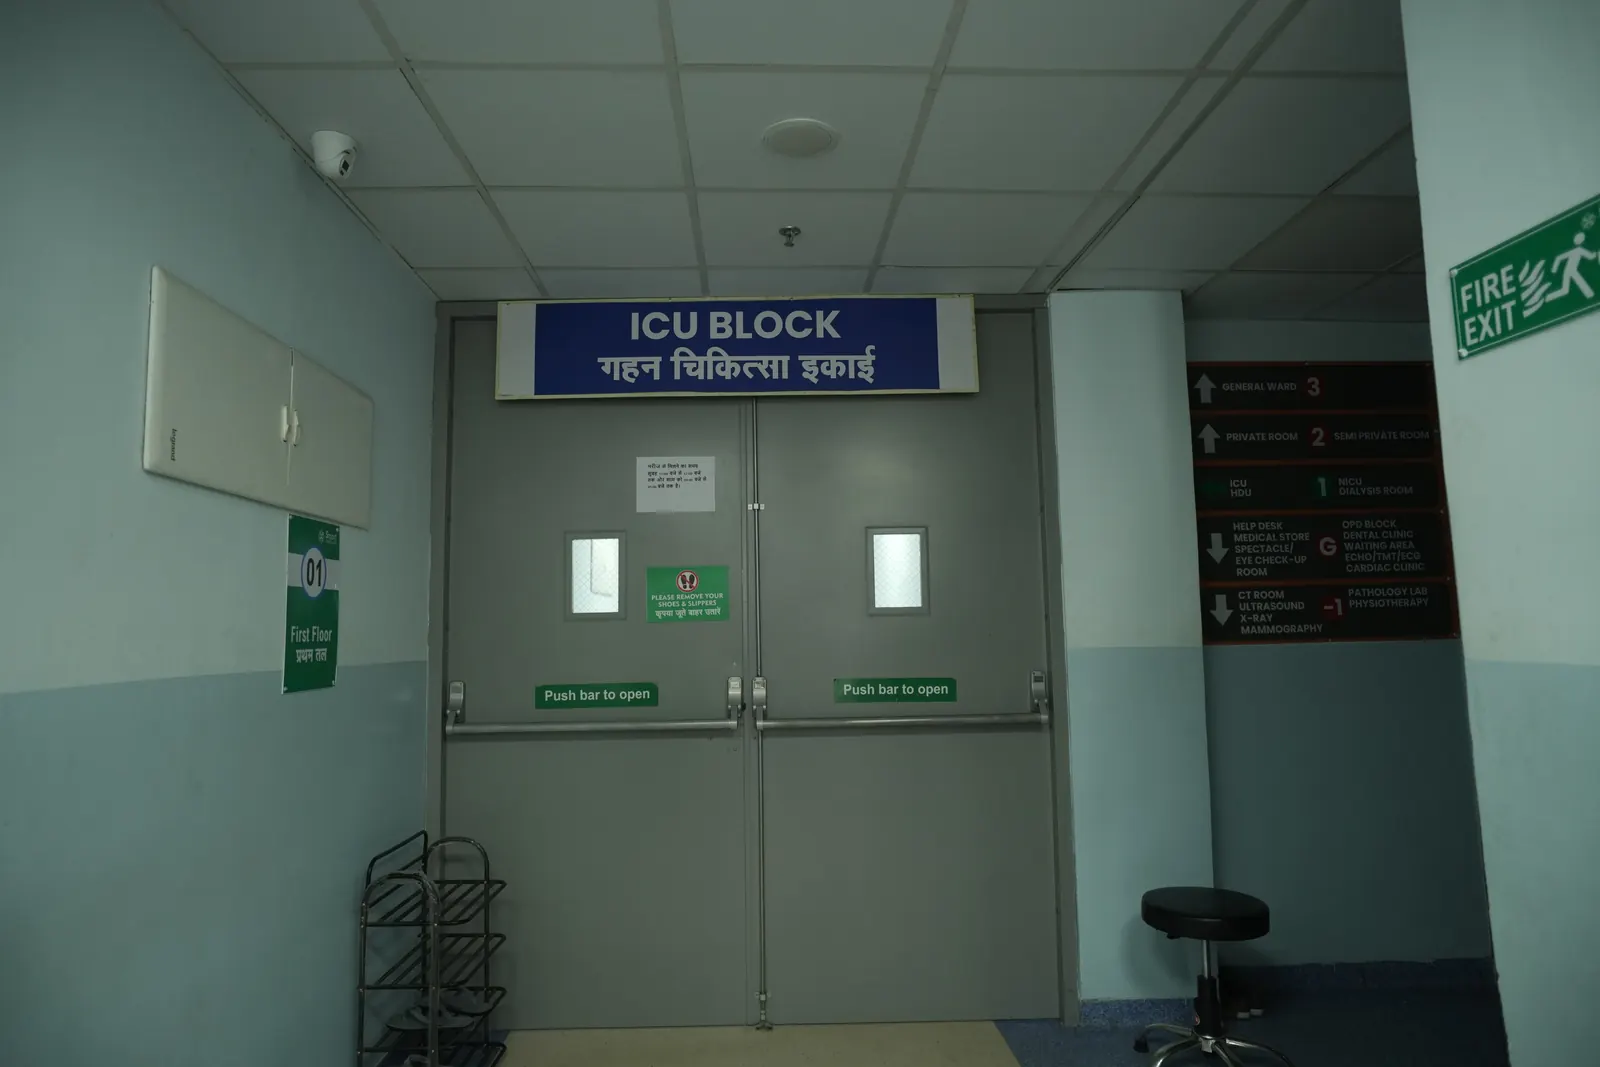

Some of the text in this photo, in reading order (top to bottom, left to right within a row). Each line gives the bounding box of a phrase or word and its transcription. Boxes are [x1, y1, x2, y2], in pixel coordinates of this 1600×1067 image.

[1460, 264, 1516, 313] FIRE
[630, 310, 841, 340] ICU BLOCK
[1464, 300, 1516, 346] EXIT
[598, 345, 875, 384] गहन चिकित्सा इकाई
[1222, 382, 1297, 391] GENERAL WARD
[1307, 377, 1320, 397] 3
[1226, 432, 1298, 441] PRIVATE ROOM
[1311, 427, 1325, 447] 2
[1334, 431, 1430, 440] SEMI PRIVATE ROOM
[1230, 479, 1247, 488] ICU
[1317, 477, 1326, 496] 1
[1231, 489, 1251, 497] HDU
[1339, 486, 1413, 496] DIALYSIS ROOM
[1233, 522, 1283, 530] HELP DESK
[1342, 520, 1396, 529] OPD BLOCK
[1233, 533, 1310, 542] MEDICAL STORE
[1343, 531, 1414, 539] DENTAL CLINIC
[1235, 542, 1294, 553] SPECTACLE/
[1319, 537, 1337, 556] G
[1344, 541, 1415, 550] WAITING AREA
[1236, 556, 1307, 564] EYE CHECK-UP
[1345, 550, 1421, 563] ECHO/TMT/ECG
[306, 558, 322, 587] 01
[1237, 568, 1268, 576] ROOM
[1346, 563, 1425, 572] CARDIAC CLINIC
[1238, 591, 1284, 599] CT ROOM
[1348, 587, 1428, 597] PATHOLOGY LAB
[1239, 602, 1305, 611] ULTRASOUND
[1323, 598, 1343, 616] -1
[1349, 598, 1429, 608] PHYSIOTHERAPY
[655, 610, 673, 619] कृपया
[675, 608, 686, 618] जूते
[1240, 614, 1273, 623] X-RAY
[1241, 624, 1323, 634] MAMMOGRAPHY
[291, 626, 332, 643] First Floor
[296, 648, 327, 663] प्रथम तल
[843, 684, 948, 697] Push bar to open
[545, 690, 650, 702] Push bar to open
